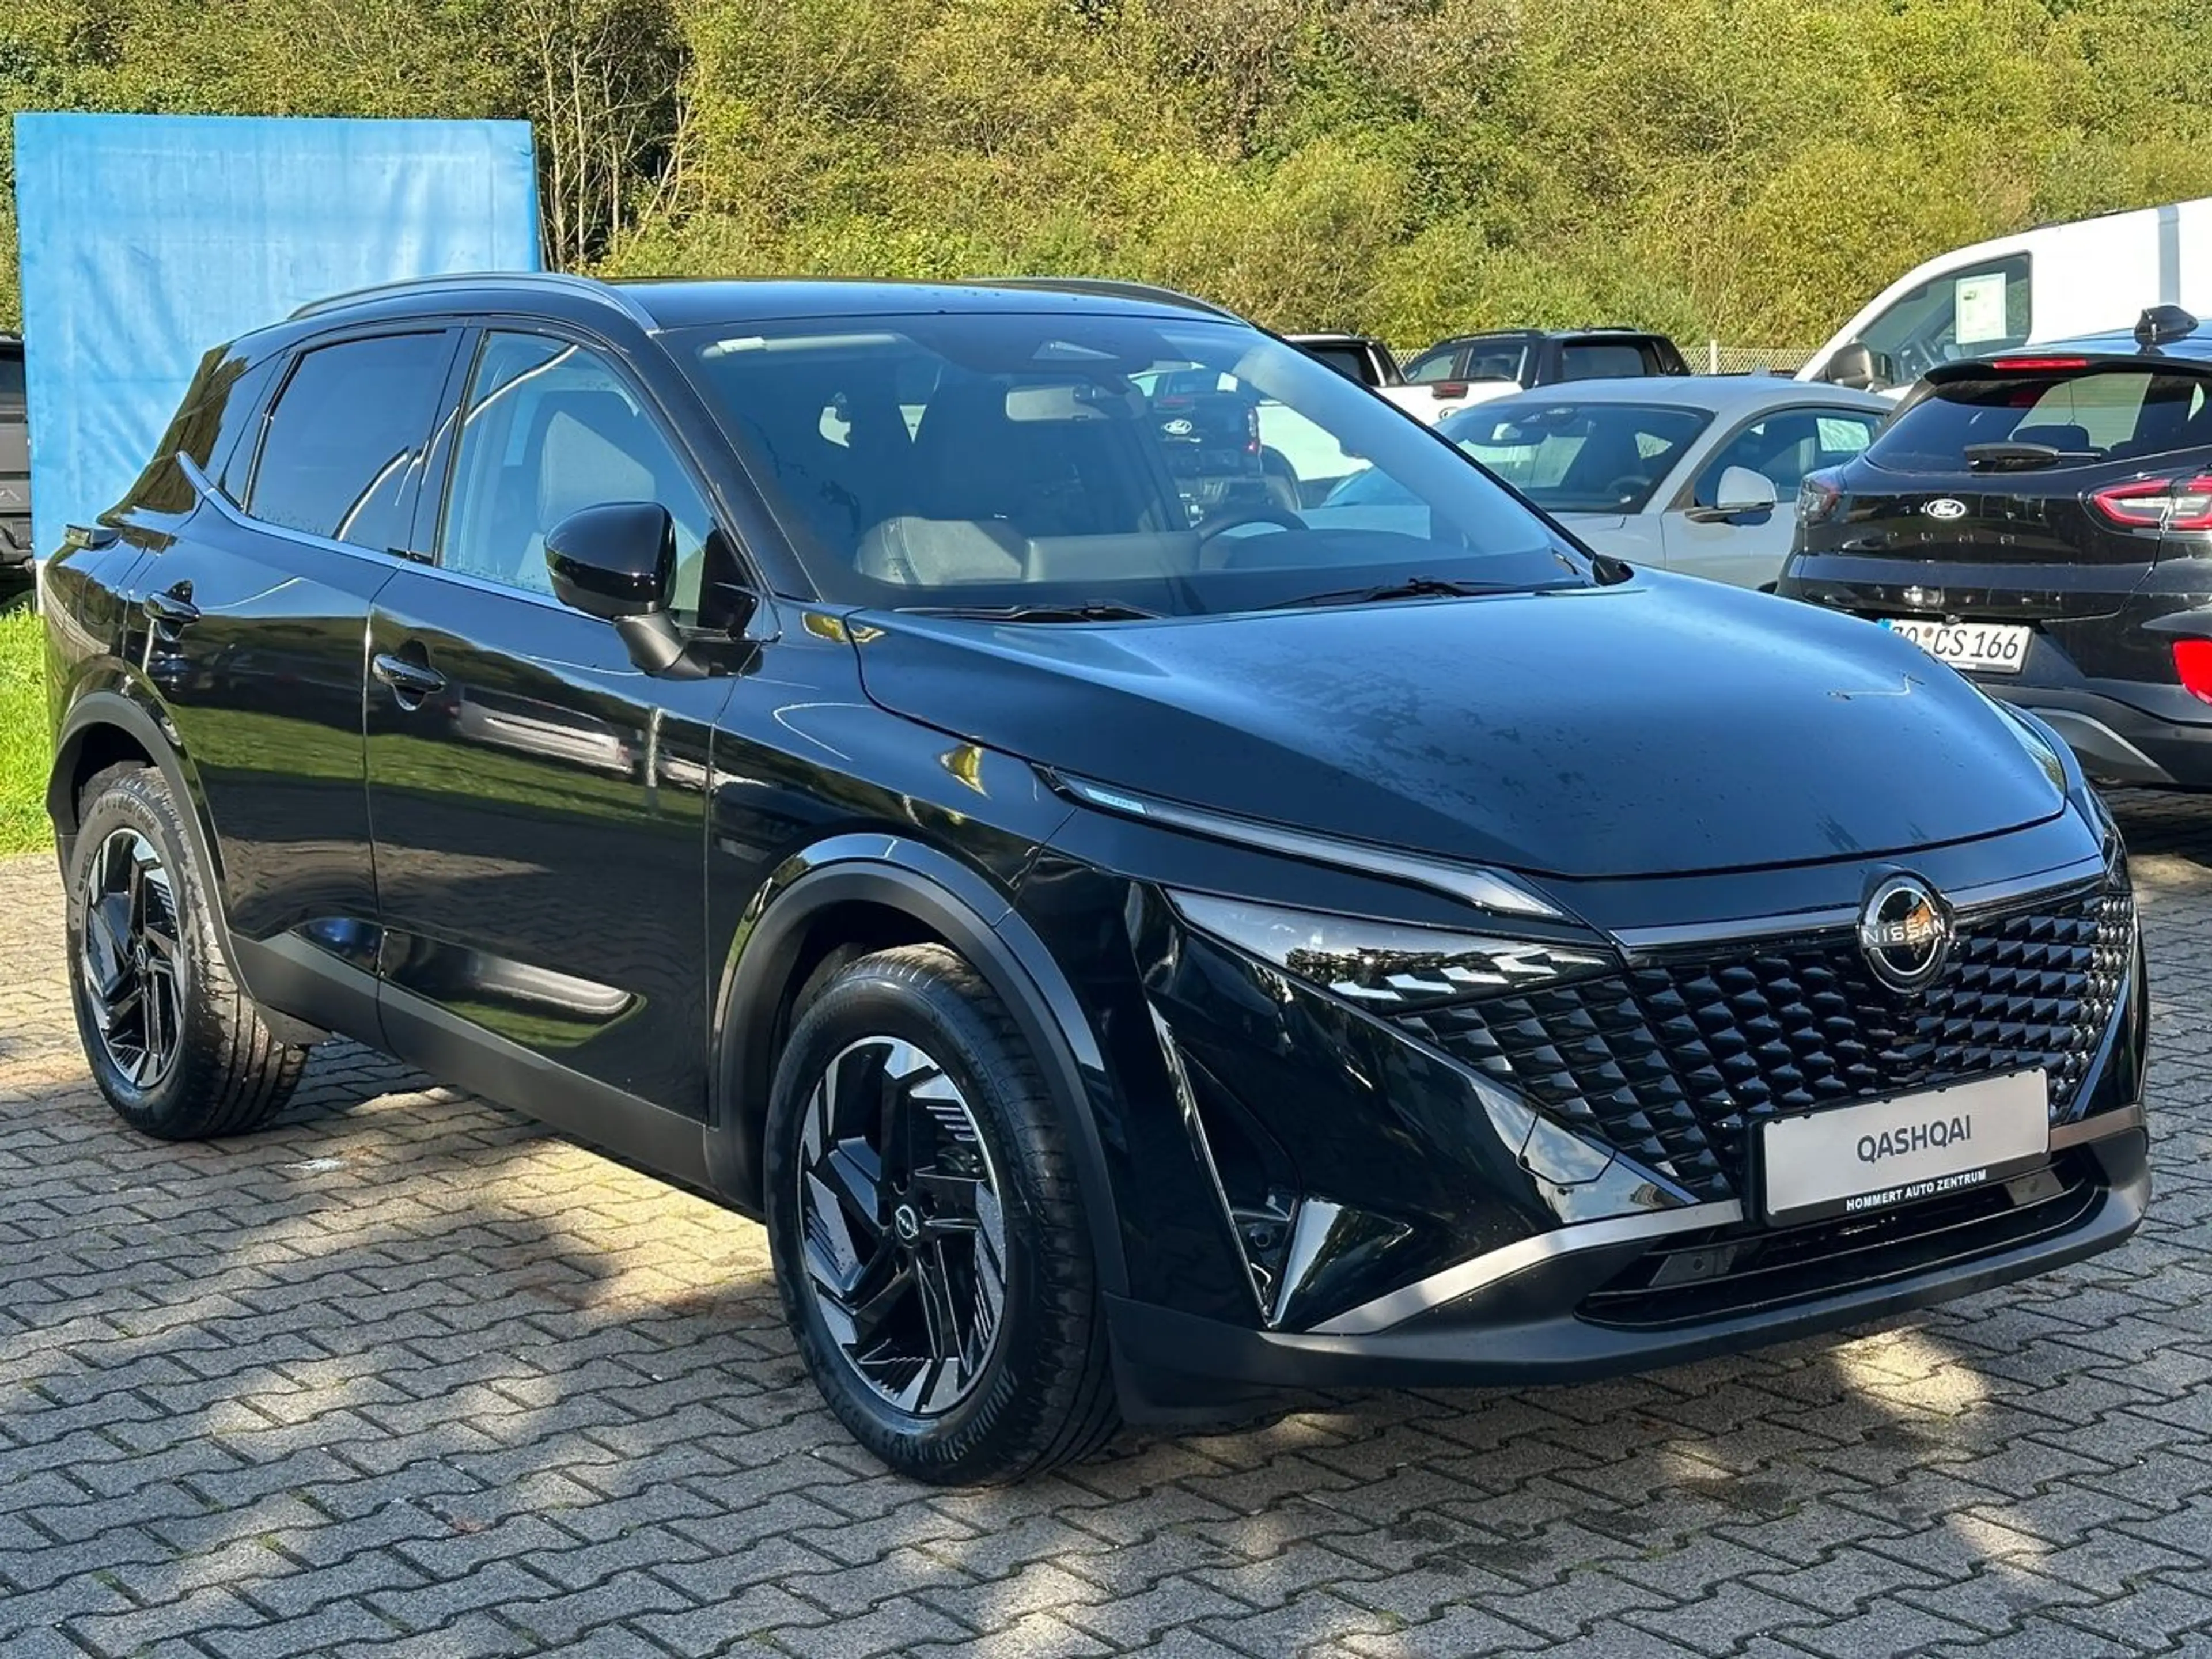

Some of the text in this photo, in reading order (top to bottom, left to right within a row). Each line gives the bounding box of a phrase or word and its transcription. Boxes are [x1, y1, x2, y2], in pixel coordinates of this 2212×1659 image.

[1933, 628, 1967, 656] CS
[1969, 631, 2018, 660] 166
[1862, 918, 1946, 944] NISSAN
[1857, 1115, 1971, 1163] QASHQAI
[1846, 1169, 1987, 1211] HOMMERT AUTO ZENTRUM
